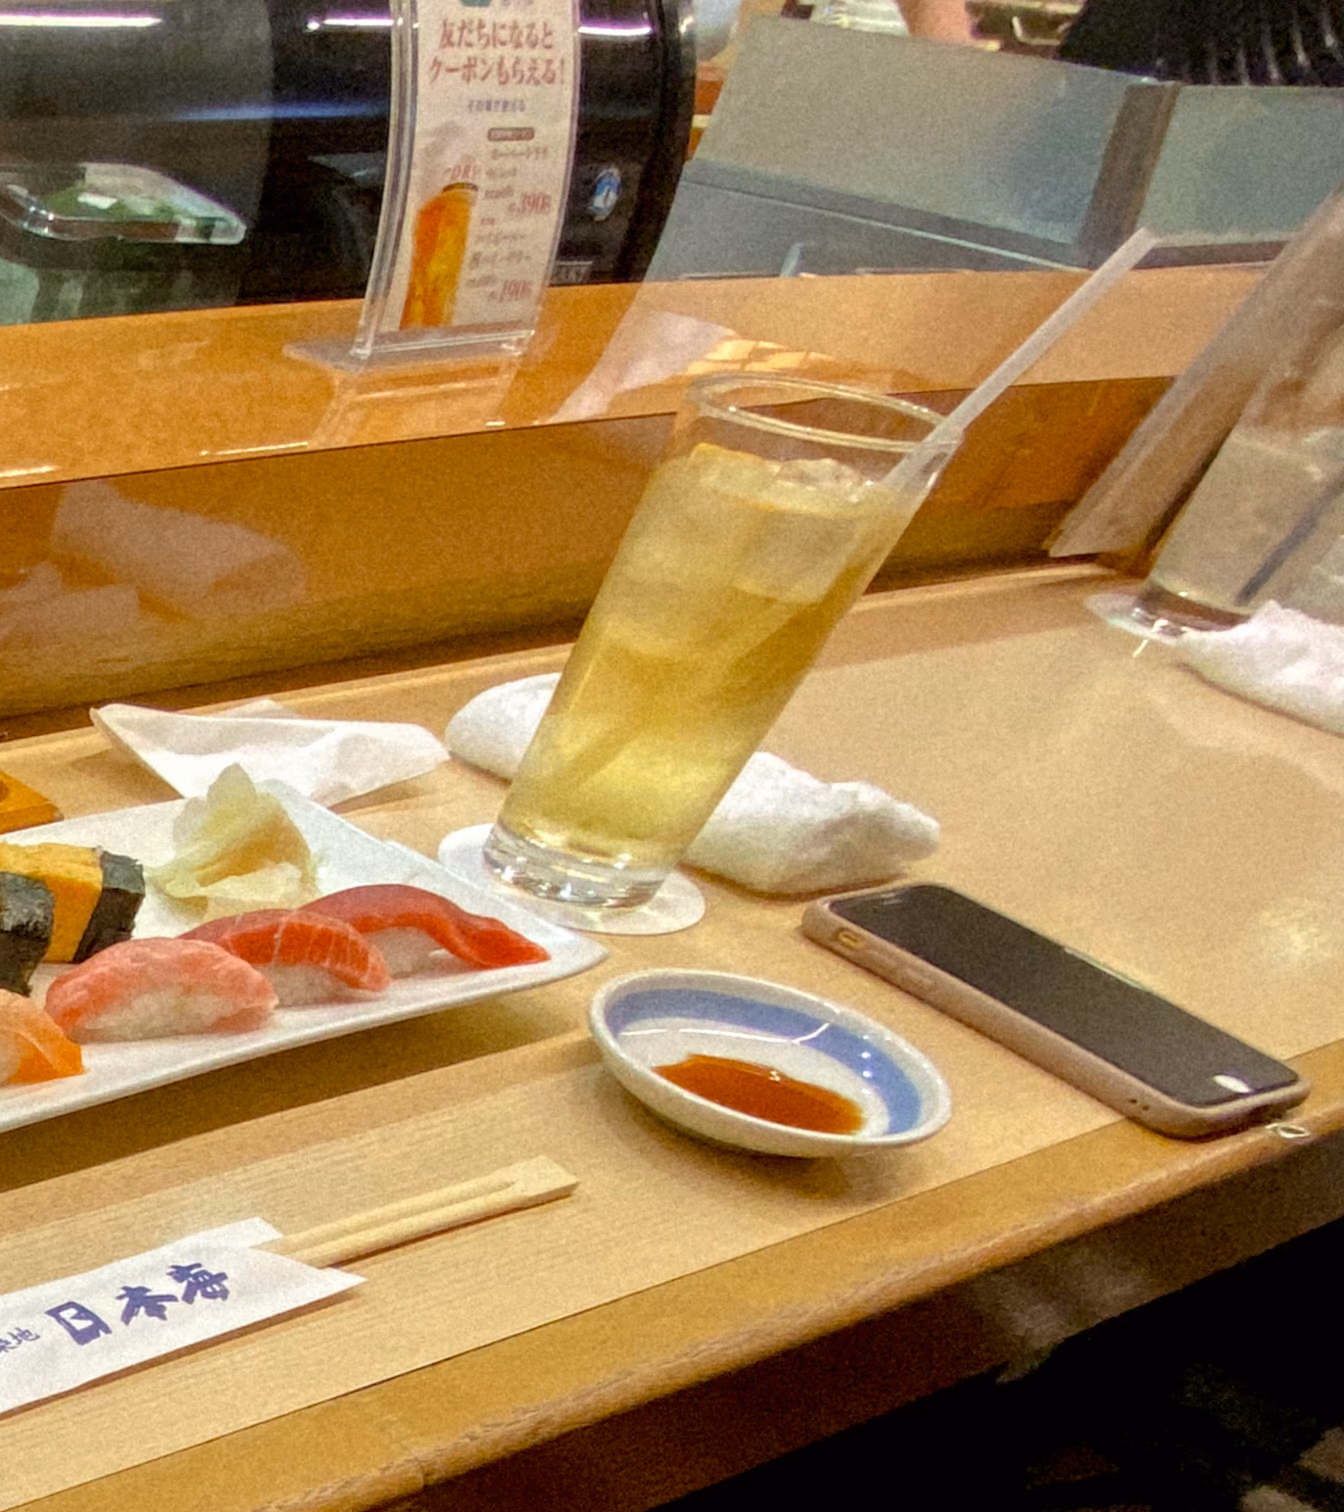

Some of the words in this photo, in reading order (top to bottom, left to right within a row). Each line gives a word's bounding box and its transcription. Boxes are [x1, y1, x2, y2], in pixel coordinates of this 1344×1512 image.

[441, 18, 553, 49] 友だちになると
[46, 1263, 230, 1346] 日本海
